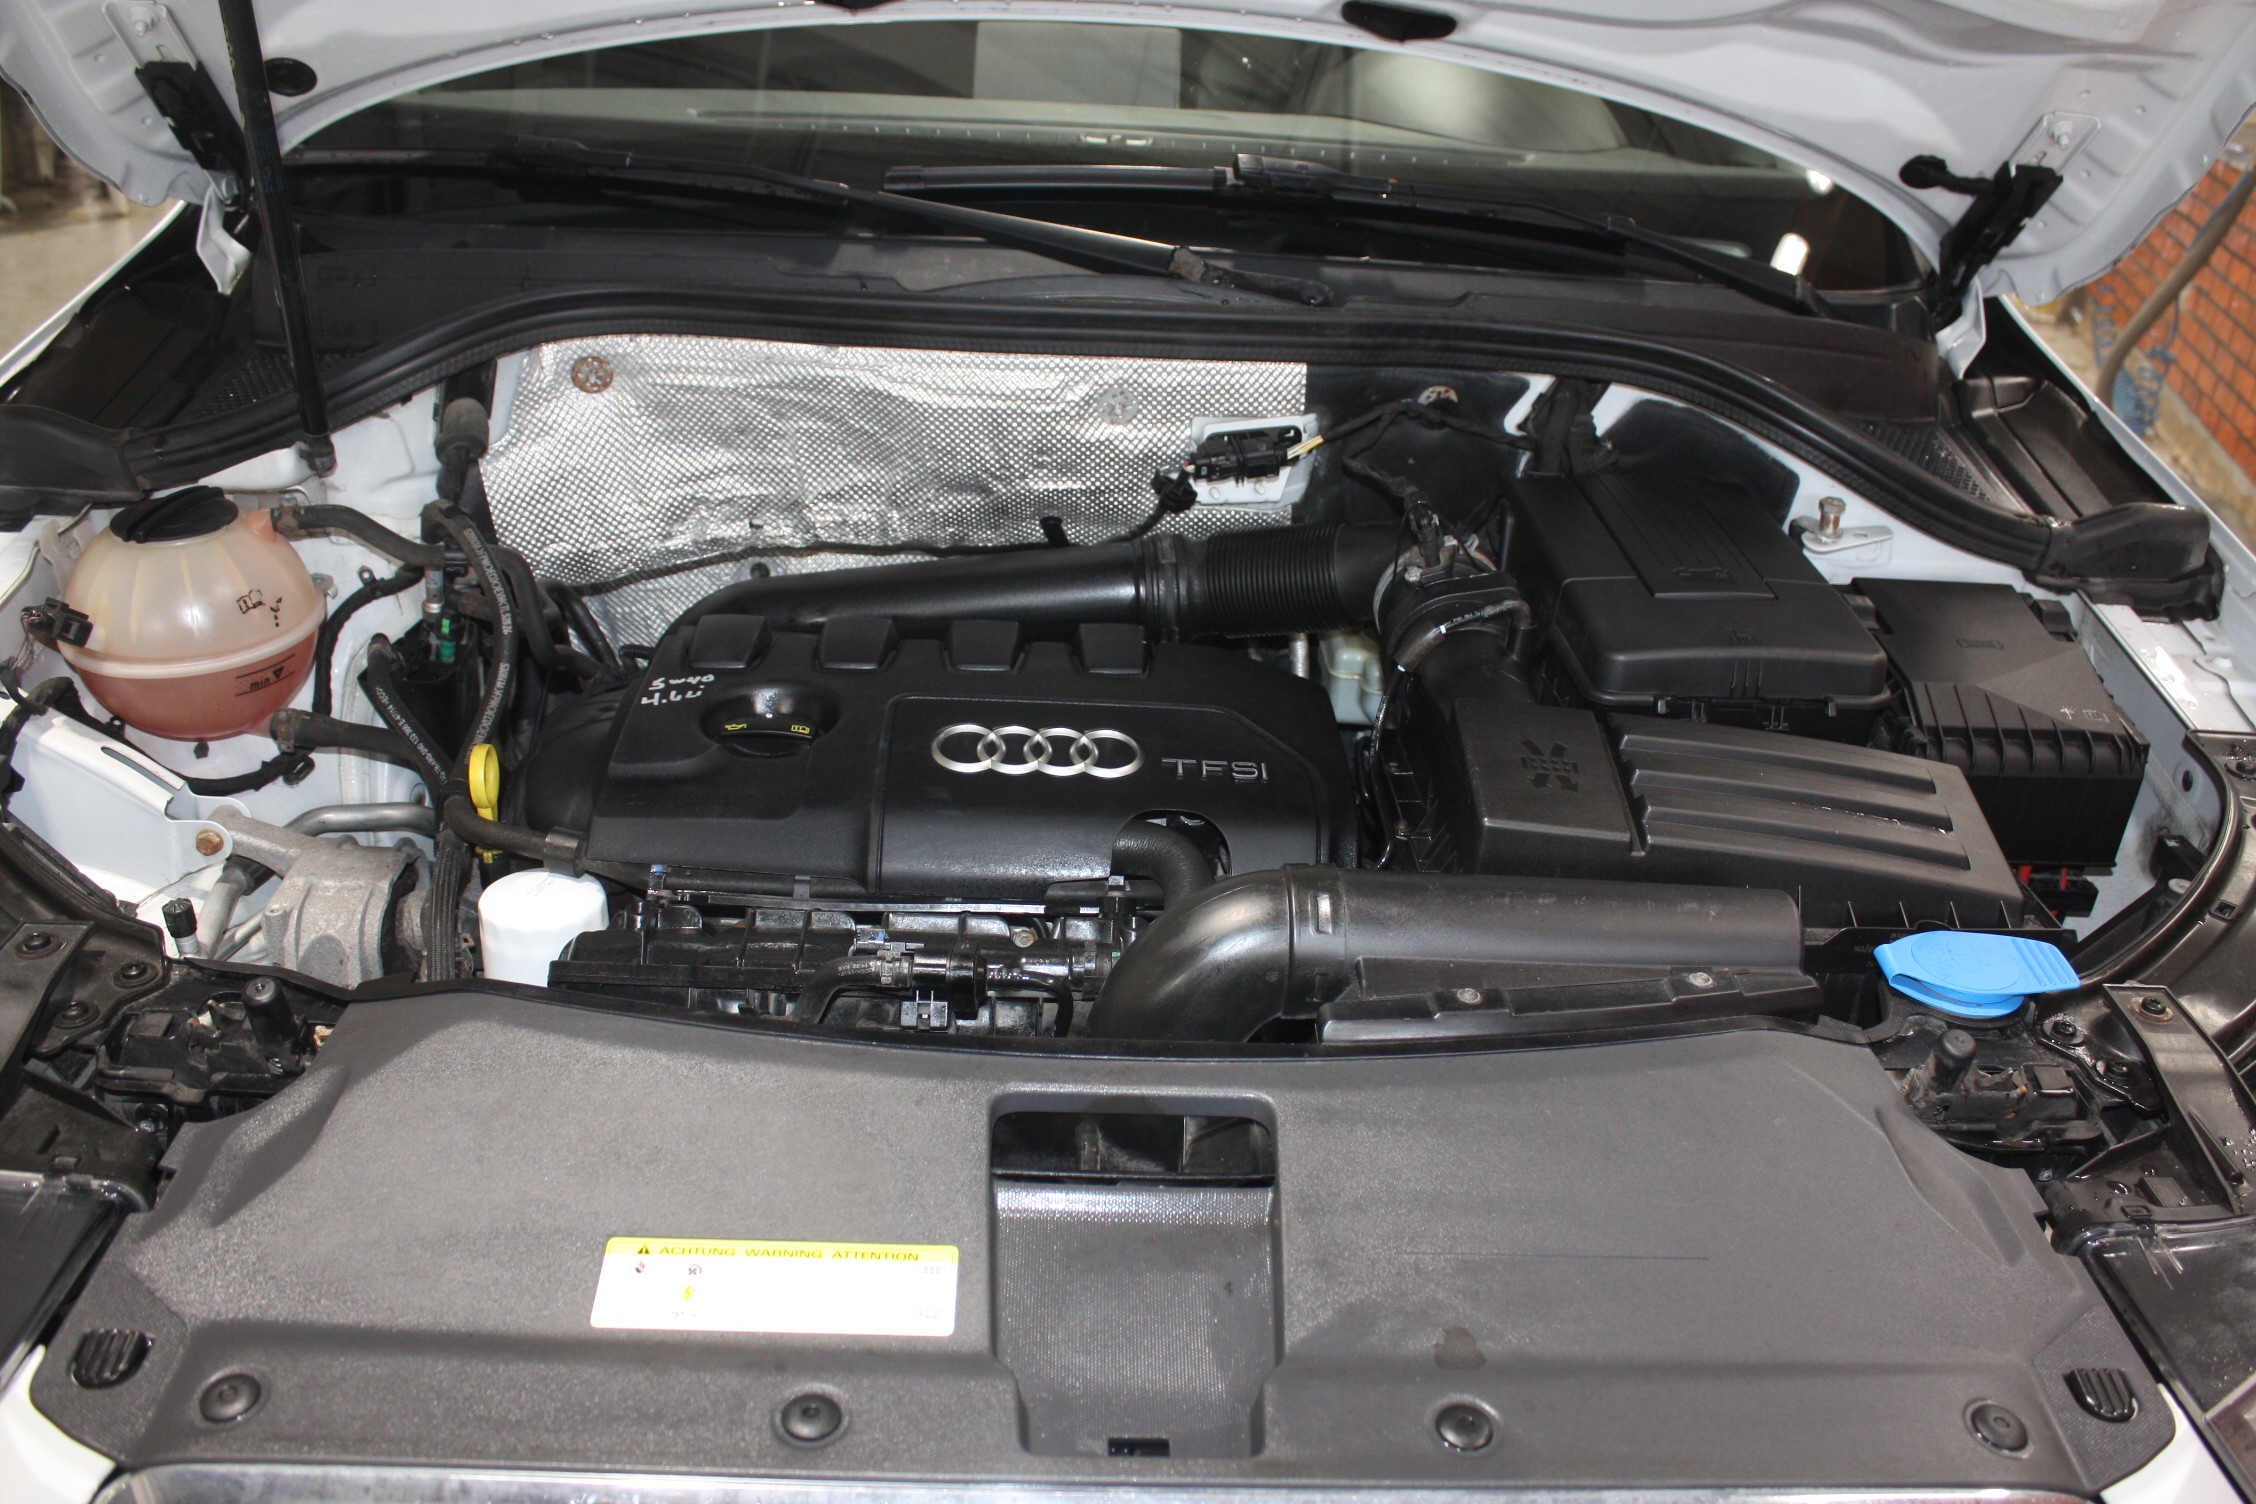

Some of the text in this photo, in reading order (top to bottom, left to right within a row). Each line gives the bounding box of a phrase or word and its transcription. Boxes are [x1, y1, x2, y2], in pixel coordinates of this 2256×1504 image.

[250, 676, 270, 690] min
[1161, 757, 1269, 781] TFSI
[659, 1246, 920, 1261] ACHTUNG WARNING ATTENTION
